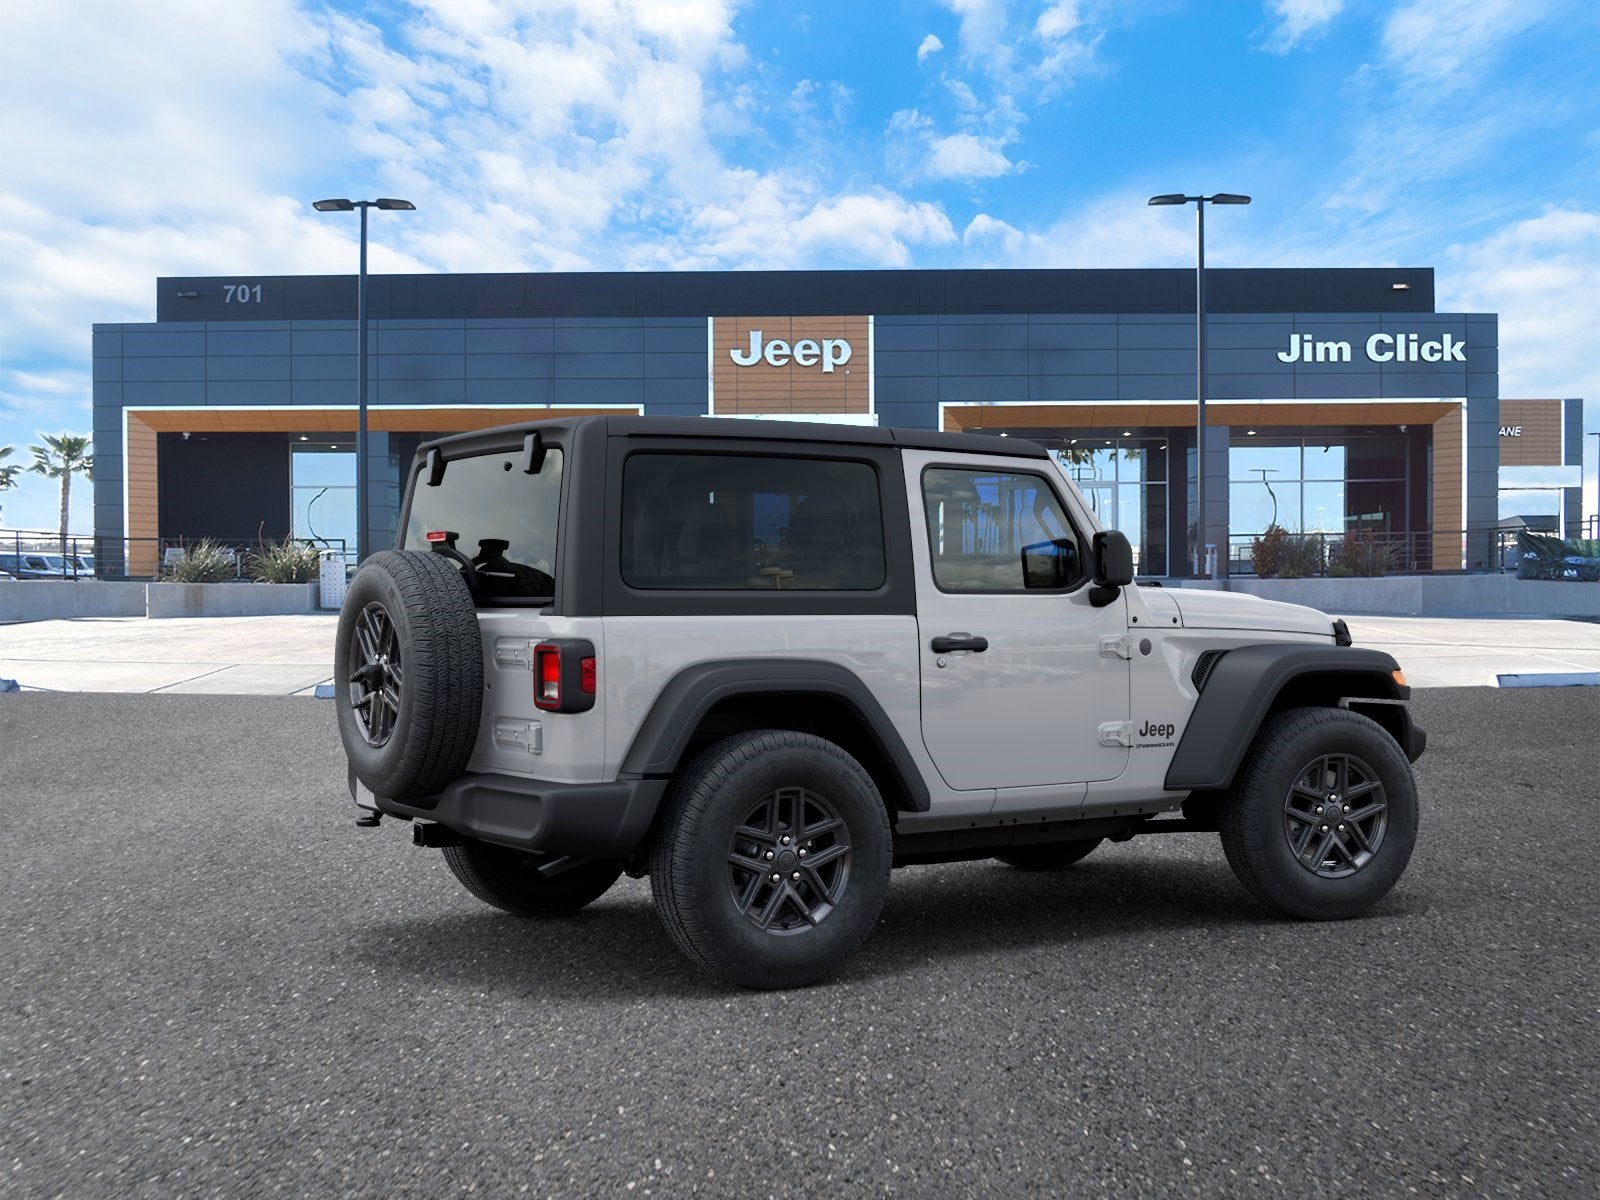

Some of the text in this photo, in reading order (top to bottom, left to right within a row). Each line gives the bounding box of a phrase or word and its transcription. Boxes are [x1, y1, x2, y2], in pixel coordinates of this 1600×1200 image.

[223, 284, 262, 304] 701
[730, 330, 852, 373] Jeep
[1277, 333, 1467, 363] Jim Click
[1139, 720, 1175, 740] Jeep
